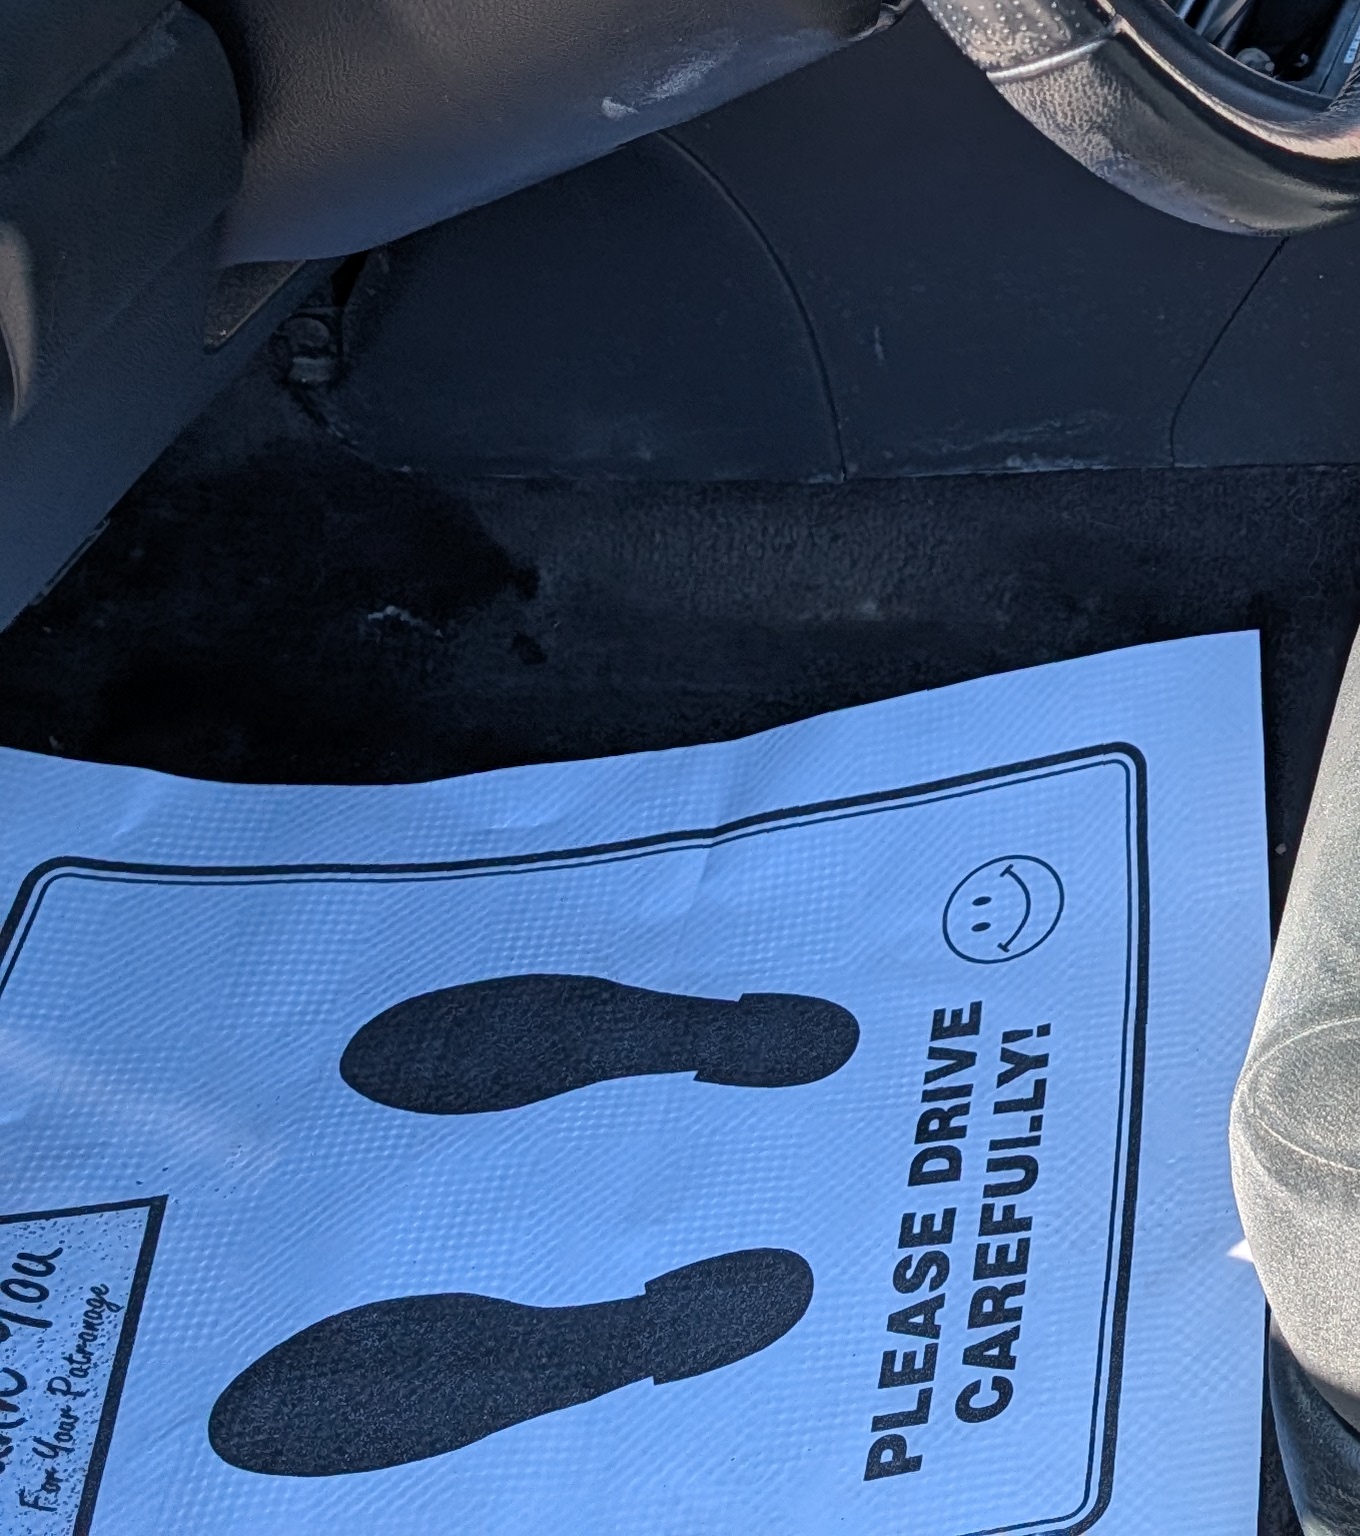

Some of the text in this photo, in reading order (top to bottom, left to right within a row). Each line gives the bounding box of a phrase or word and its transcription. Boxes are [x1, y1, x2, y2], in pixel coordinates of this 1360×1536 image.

[18, 1282, 126, 1513] For Your Patronage
[864, 1000, 983, 1482] PLEASE DRIVE
[955, 1022, 1052, 1424] CAREFULLY!
